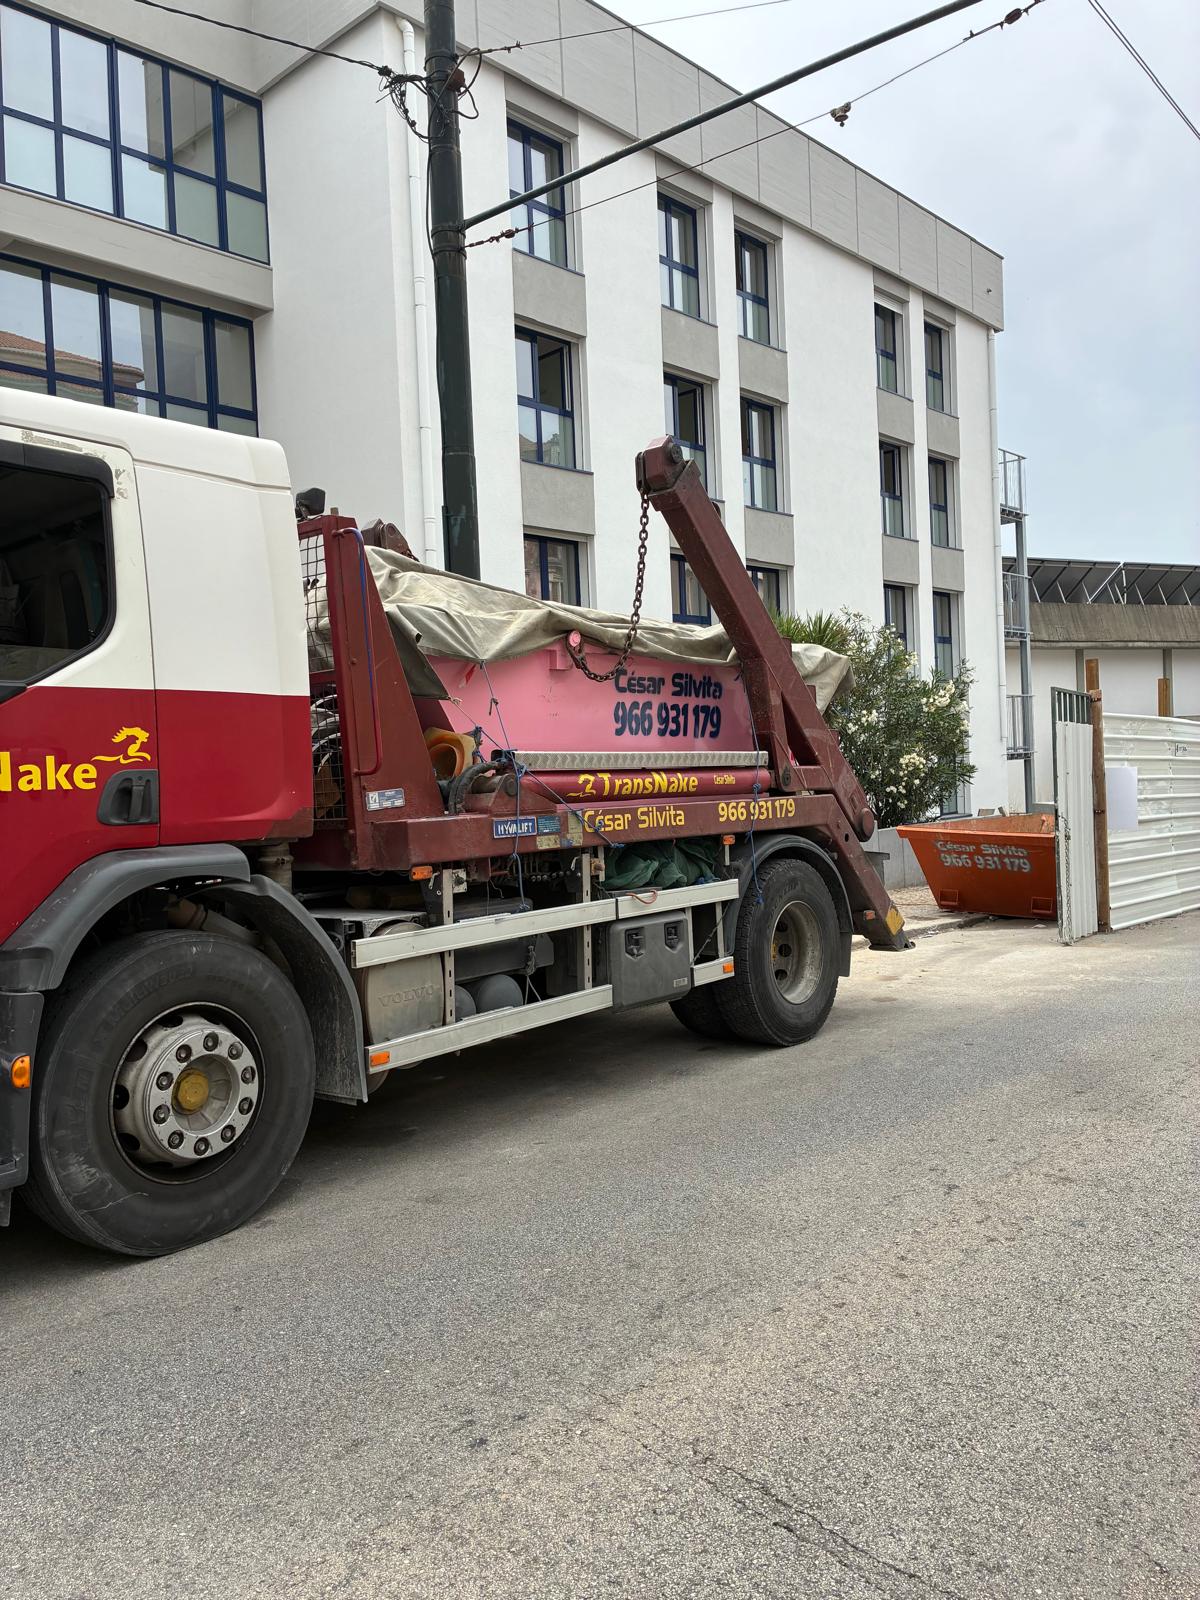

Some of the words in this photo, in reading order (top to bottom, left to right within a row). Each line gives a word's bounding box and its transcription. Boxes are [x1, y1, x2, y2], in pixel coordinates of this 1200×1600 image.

[614, 669, 665, 695] César
[671, 672, 722, 699] Silvita
[613, 700, 653, 737] 966
[657, 702, 689, 737] 931
[693, 704, 721, 739] 179
[597, 771, 699, 797] TransNake
[584, 809, 631, 833] César
[637, 805, 685, 829] Silvita
[718, 801, 747, 822] 966
[750, 801, 773, 820] 931
[774, 798, 795, 818] 179
[941, 853, 972, 868] 966
[974, 855, 1002, 870] 931
[1003, 857, 1032, 873] 179
